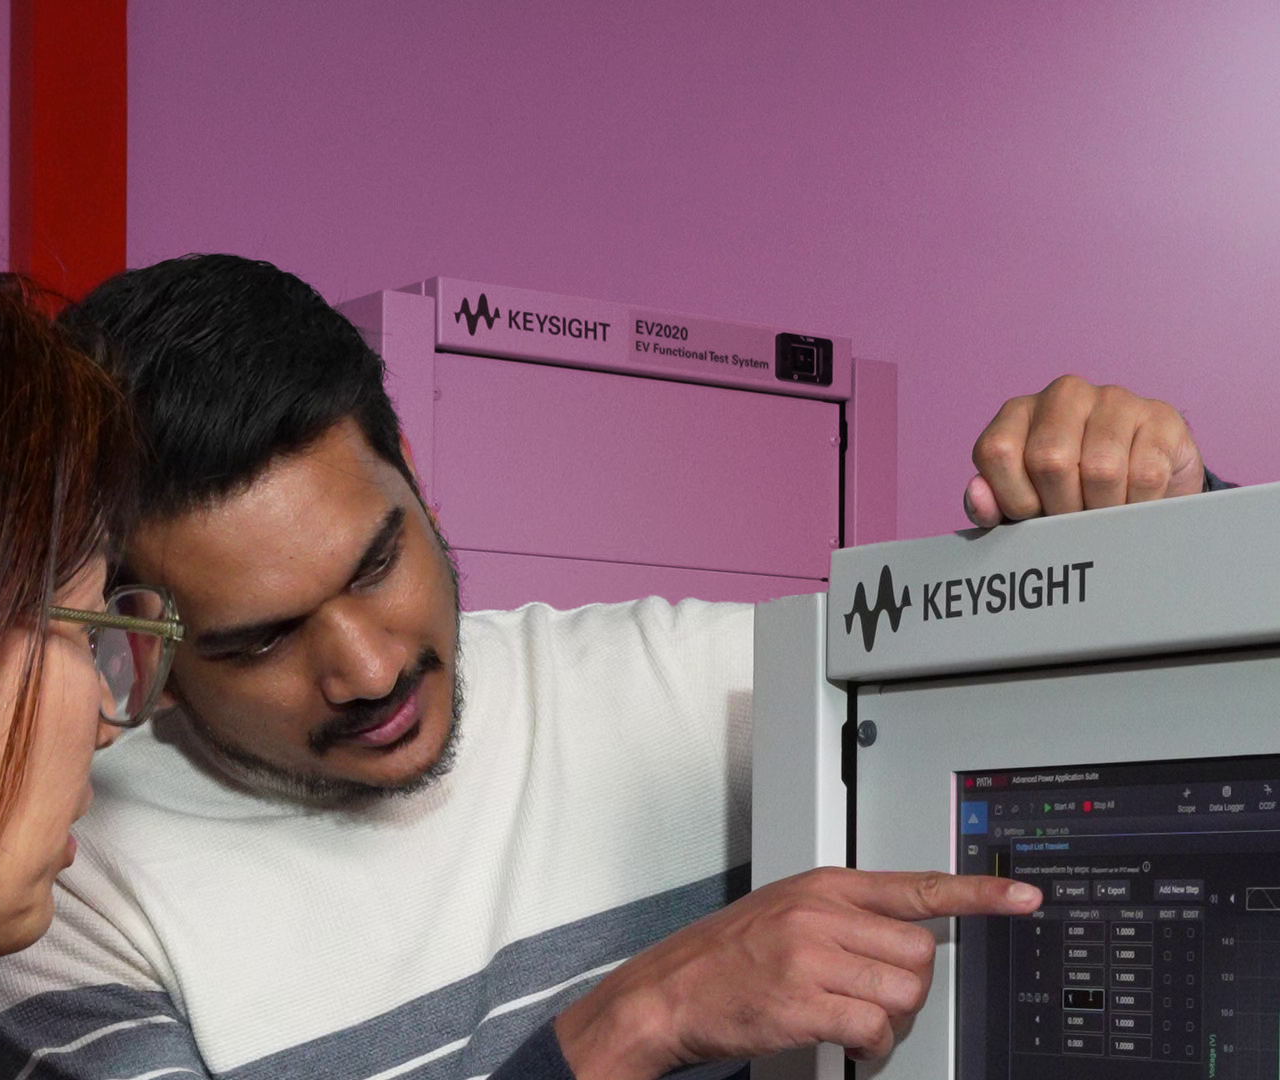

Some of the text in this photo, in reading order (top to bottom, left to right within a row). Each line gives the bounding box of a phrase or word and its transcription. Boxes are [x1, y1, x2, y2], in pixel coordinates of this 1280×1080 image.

[508, 310, 610, 342] KEYSIGHT
[636, 320, 688, 342] EV2020
[636, 341, 770, 370] EV Functional Test System
[923, 561, 1094, 622] KEYSIGHT
[1012, 776, 1036, 784] Advanced
[1038, 775, 1054, 783] Power
[1055, 773, 1084, 783] Application
[1085, 773, 1100, 781] Suite
[1094, 802, 1106, 810] Stop
[1177, 805, 1196, 814] Scope
[1209, 803, 1246, 813] Data Logger
[1016, 843, 1033, 852] Output
[1015, 866, 1042, 874] Construct
[1043, 865, 1068, 874] waveform
[1067, 887, 1084, 896] Import
[1108, 886, 1126, 896] Export
[1159, 886, 1200, 896] Add New Step
[1069, 910, 1100, 919] Voltage (V)
[1209, 1034, 1217, 1078] Voltage (V)
